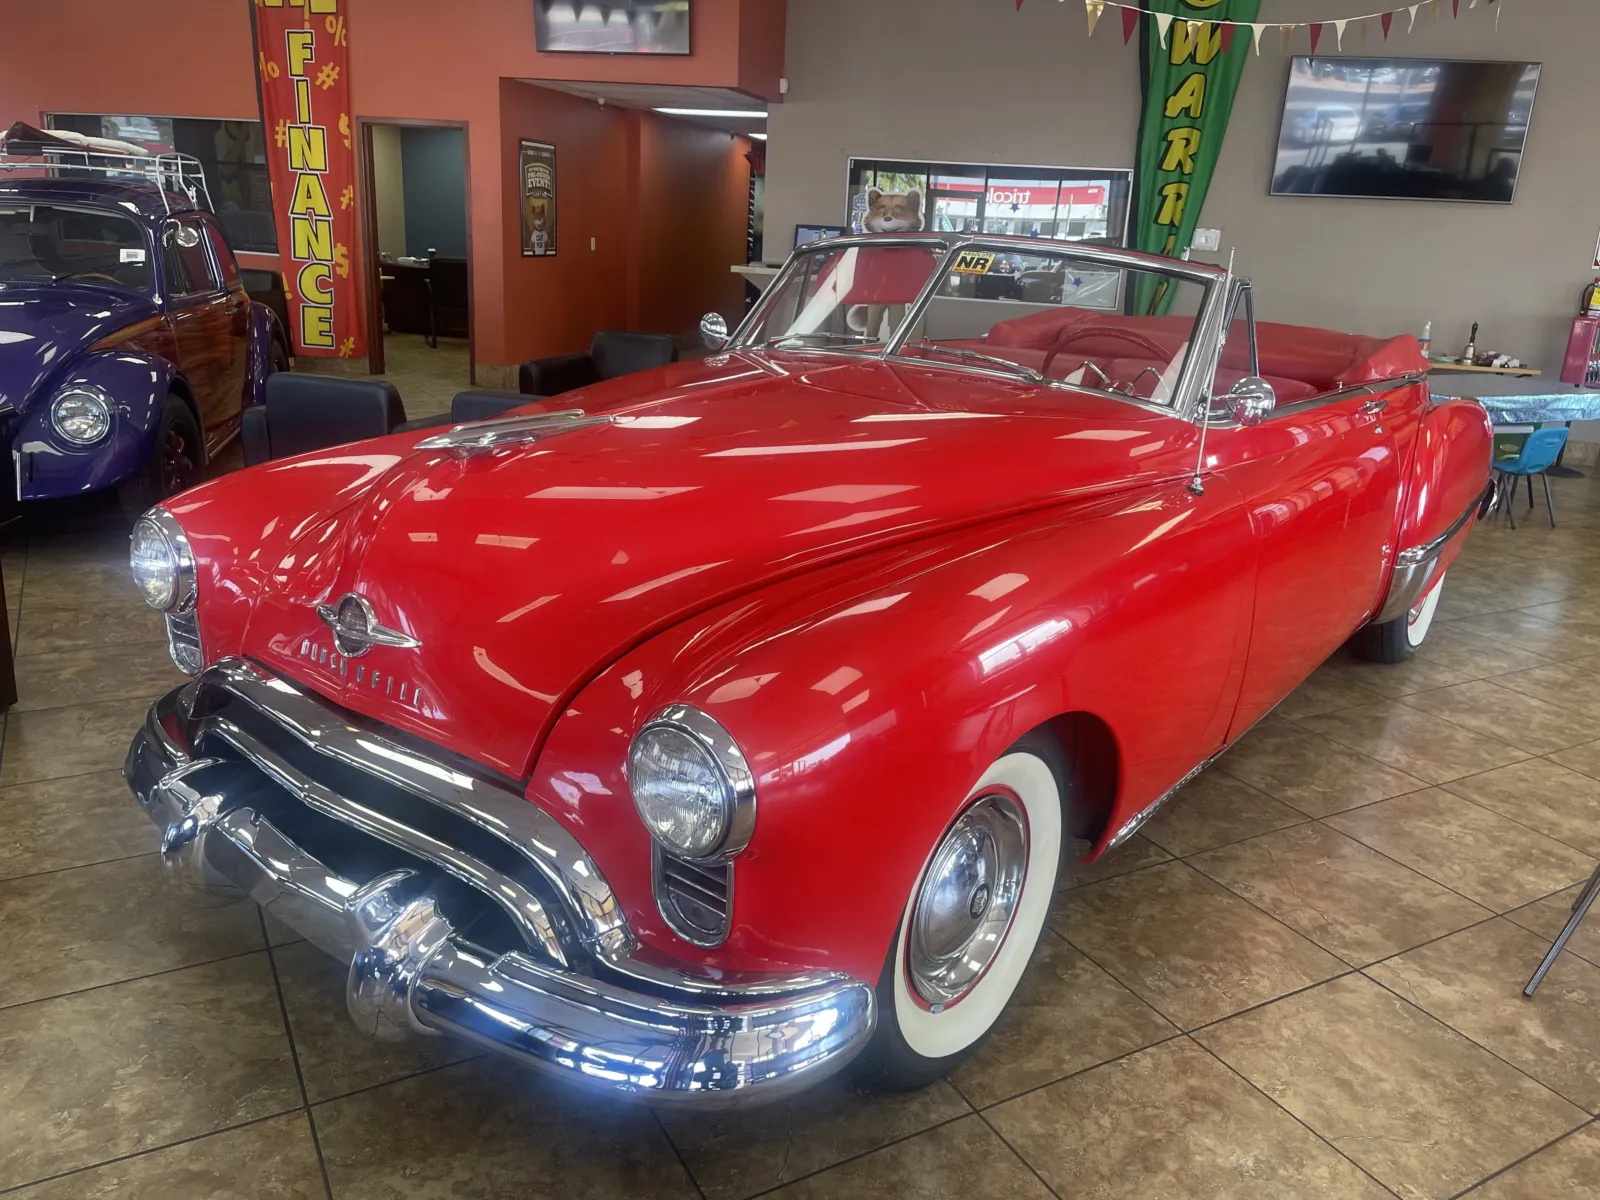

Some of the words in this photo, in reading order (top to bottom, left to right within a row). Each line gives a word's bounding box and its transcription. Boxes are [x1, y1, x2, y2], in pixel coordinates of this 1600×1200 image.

[283, 29, 334, 349] FINANCE
[528, 178, 551, 190] EVENT!
[956, 256, 989, 269] NR
